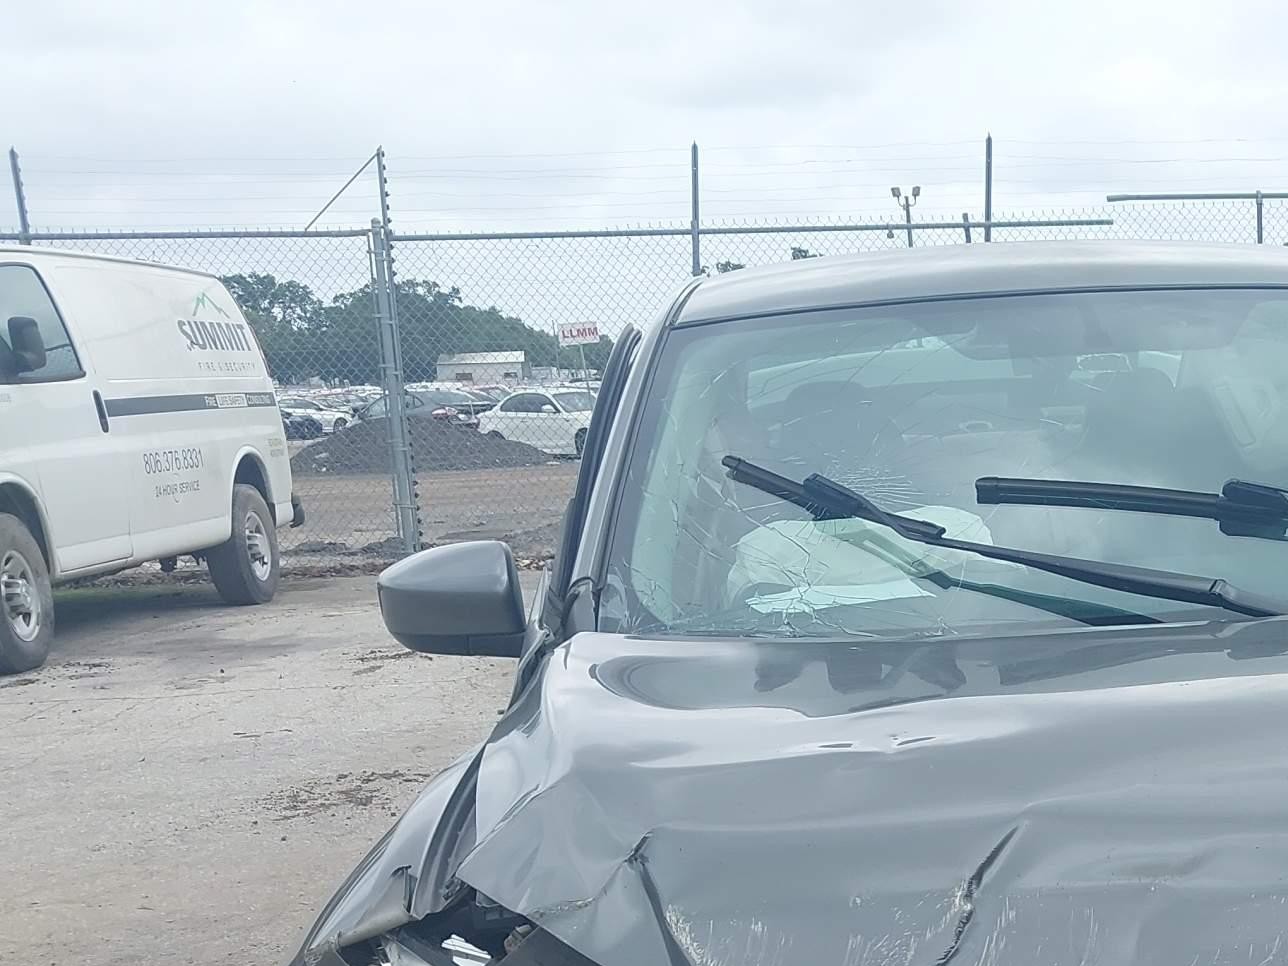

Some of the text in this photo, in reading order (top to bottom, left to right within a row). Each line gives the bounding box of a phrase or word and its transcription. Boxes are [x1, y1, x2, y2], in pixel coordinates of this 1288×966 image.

[177, 319, 252, 351] SUMMIT
[198, 361, 217, 371] FIRE
[143, 448, 204, 474] 806.376.8331
[163, 483, 178, 496] HOUR
[179, 479, 200, 493] SERVICE
